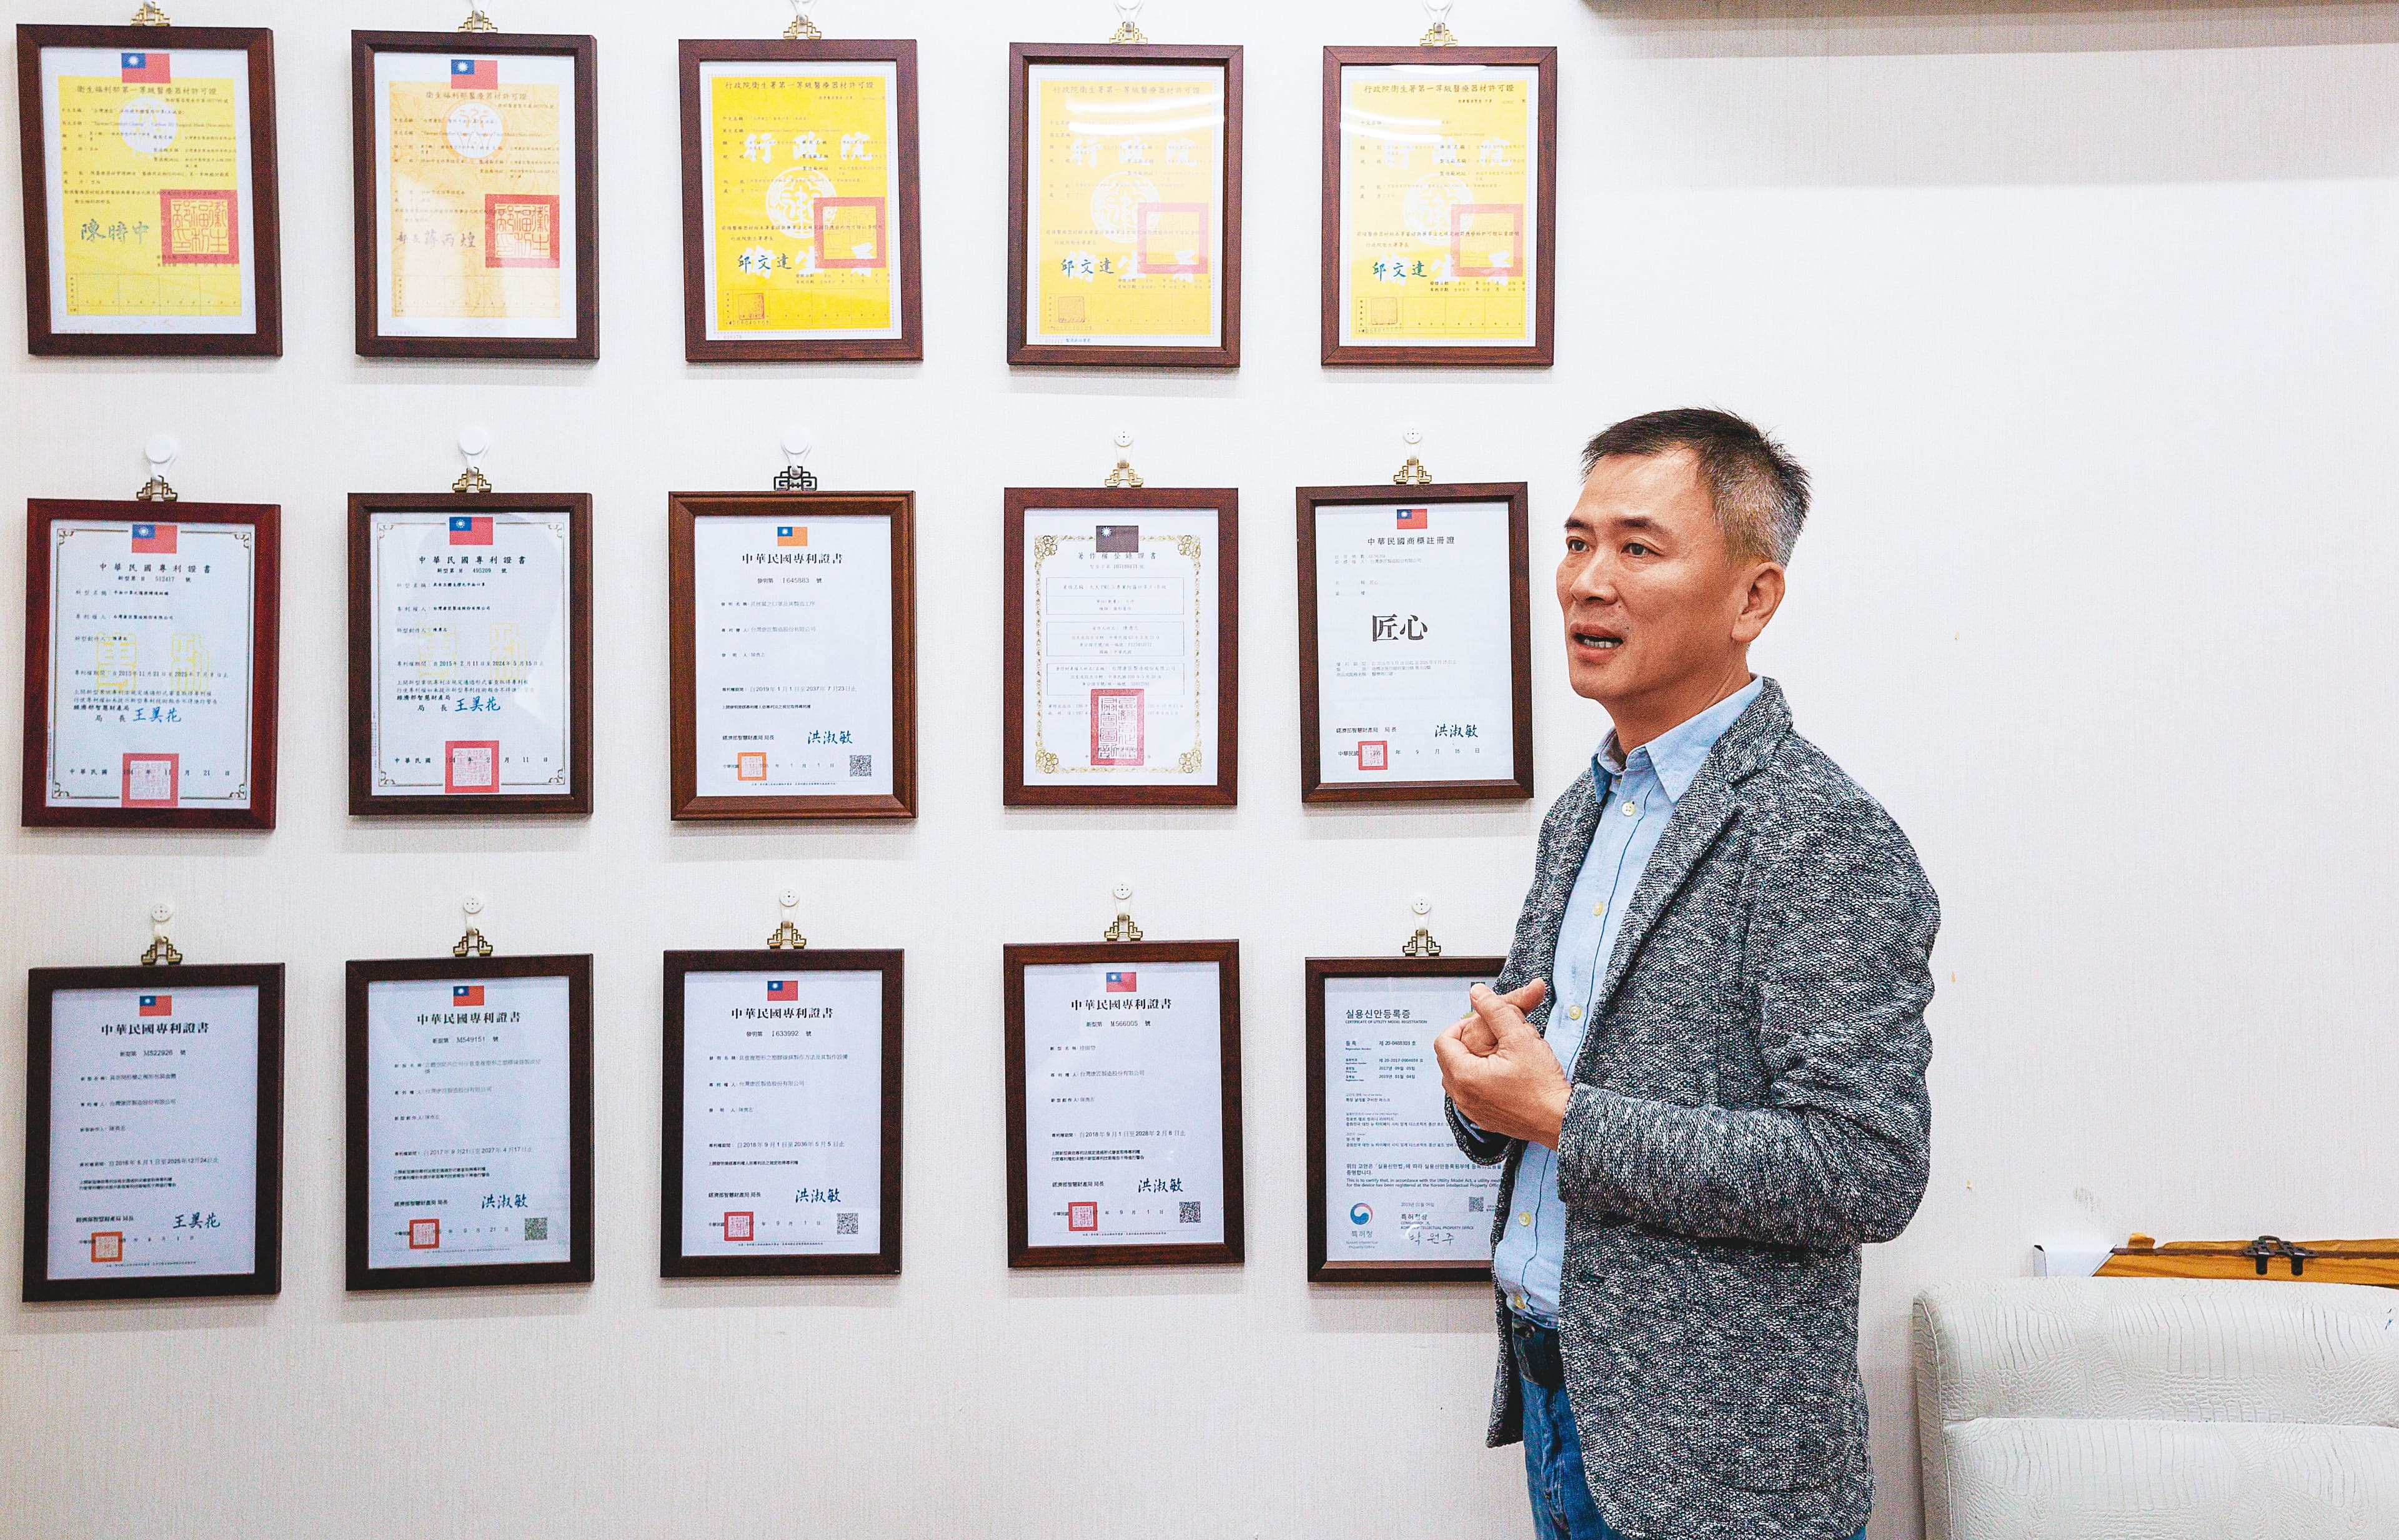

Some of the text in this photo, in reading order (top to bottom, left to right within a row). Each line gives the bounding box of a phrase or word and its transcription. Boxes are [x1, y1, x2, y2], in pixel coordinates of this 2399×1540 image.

[82, 219, 149, 244] 陳時中
[738, 254, 792, 274] 邱文達
[1060, 258, 1115, 277] 邱文達
[1373, 261, 1428, 281] 邱文達
[1368, 537, 1455, 545] 中華民國商標註冊證
[419, 556, 527, 564] 中華民國專利證書
[742, 553, 843, 564] 中華民國專利證書
[100, 564, 211, 574] 中華民國專利證書
[1372, 614, 1428, 642] 匠心
[455, 696, 500, 712] 王美花
[132, 707, 181, 723] 王美花
[808, 730, 853, 745] 洪淑敏
[1434, 723, 1478, 738] 洪淑敏
[1071, 998, 1172, 1011] 中華民國專利證書
[417, 1011, 521, 1025] 中華民國專利證書
[731, 1008, 833, 1019] 中華民國專利證書
[1346, 1009, 1411, 1019] 실용신안등록증
[101, 1022, 209, 1036] 中華民國專利證書
[1138, 1178, 1184, 1193] 洪淑敏
[482, 1194, 528, 1209] 洪淑敏
[795, 1188, 841, 1203] 洪淑敏
[173, 1212, 220, 1230] 王美花
